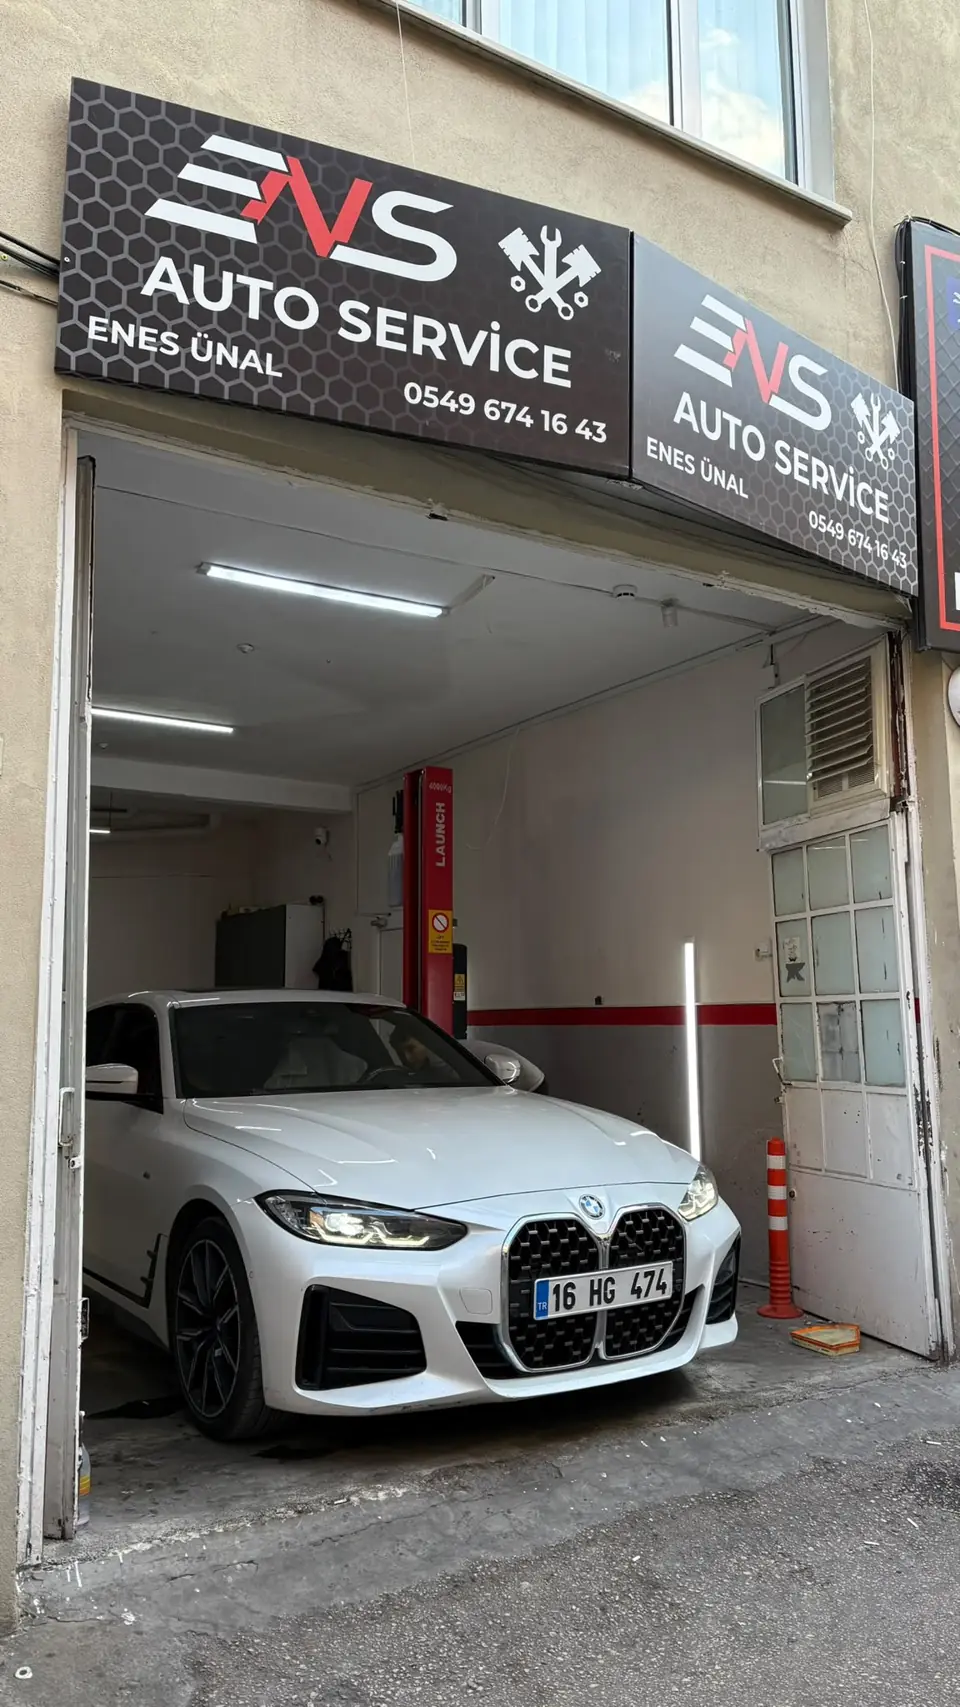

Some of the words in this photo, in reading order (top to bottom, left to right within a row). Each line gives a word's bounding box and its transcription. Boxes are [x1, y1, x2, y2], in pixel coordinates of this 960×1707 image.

[144, 134, 458, 282] ENS
[88, 315, 181, 357] ENES
[190, 332, 283, 378] ÜNAL
[140, 256, 320, 331] AUTO
[337, 299, 573, 389] SERVİCE
[673, 294, 833, 431] ENS
[404, 381, 476, 416] 0549
[483, 399, 534, 428] 674
[540, 409, 568, 435] 16
[574, 419, 608, 444] 43
[646, 436, 696, 475] ENES
[700, 455, 749, 499] ÜNAL
[673, 391, 766, 462] AUTO
[774, 439, 890, 525] SERVİCE
[808, 510, 844, 541] 0549
[848, 530, 874, 555] 674
[874, 539, 889, 561] 16
[891, 550, 908, 569] 43
[435, 801, 446, 868] LAUNCH
[537, 1301, 548, 1311] TR
[552, 1282, 577, 1312] 16
[589, 1276, 616, 1306] HG
[630, 1268, 667, 1300] 474
